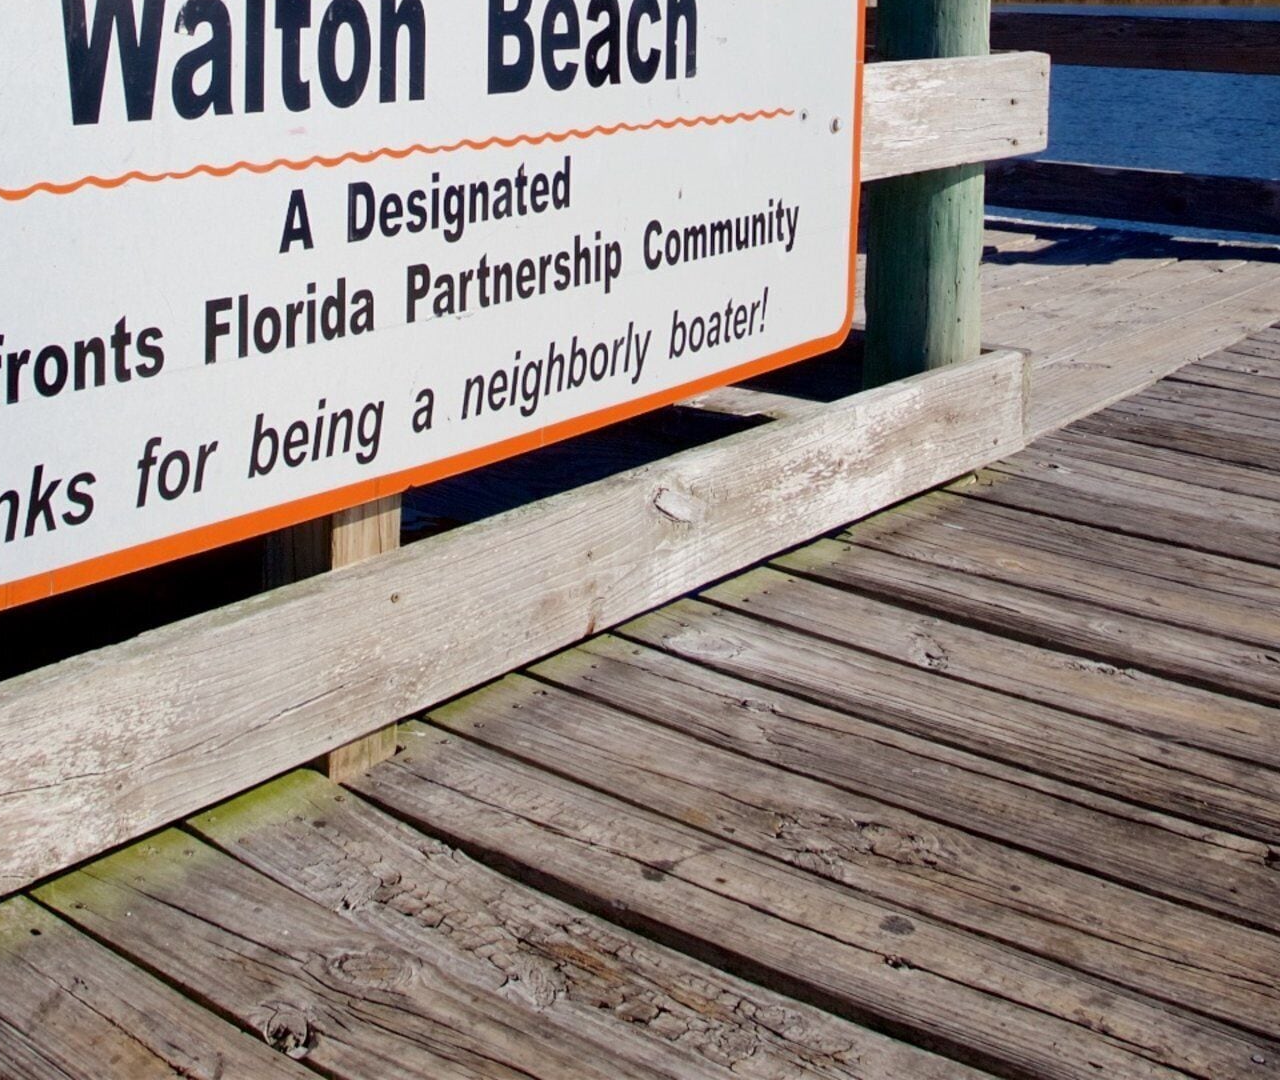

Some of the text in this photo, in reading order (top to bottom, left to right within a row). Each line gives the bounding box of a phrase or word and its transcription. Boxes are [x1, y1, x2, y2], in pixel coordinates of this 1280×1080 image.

[205, 278, 374, 364] Florida
[407, 235, 621, 323] Partnership
[644, 200, 799, 270] Community
[280, 156, 570, 253] A Designated
[137, 437, 218, 507] for
[249, 399, 384, 478] being
[413, 389, 433, 432] a
[462, 322, 651, 419] neighborly
[669, 287, 768, 358] boater!
